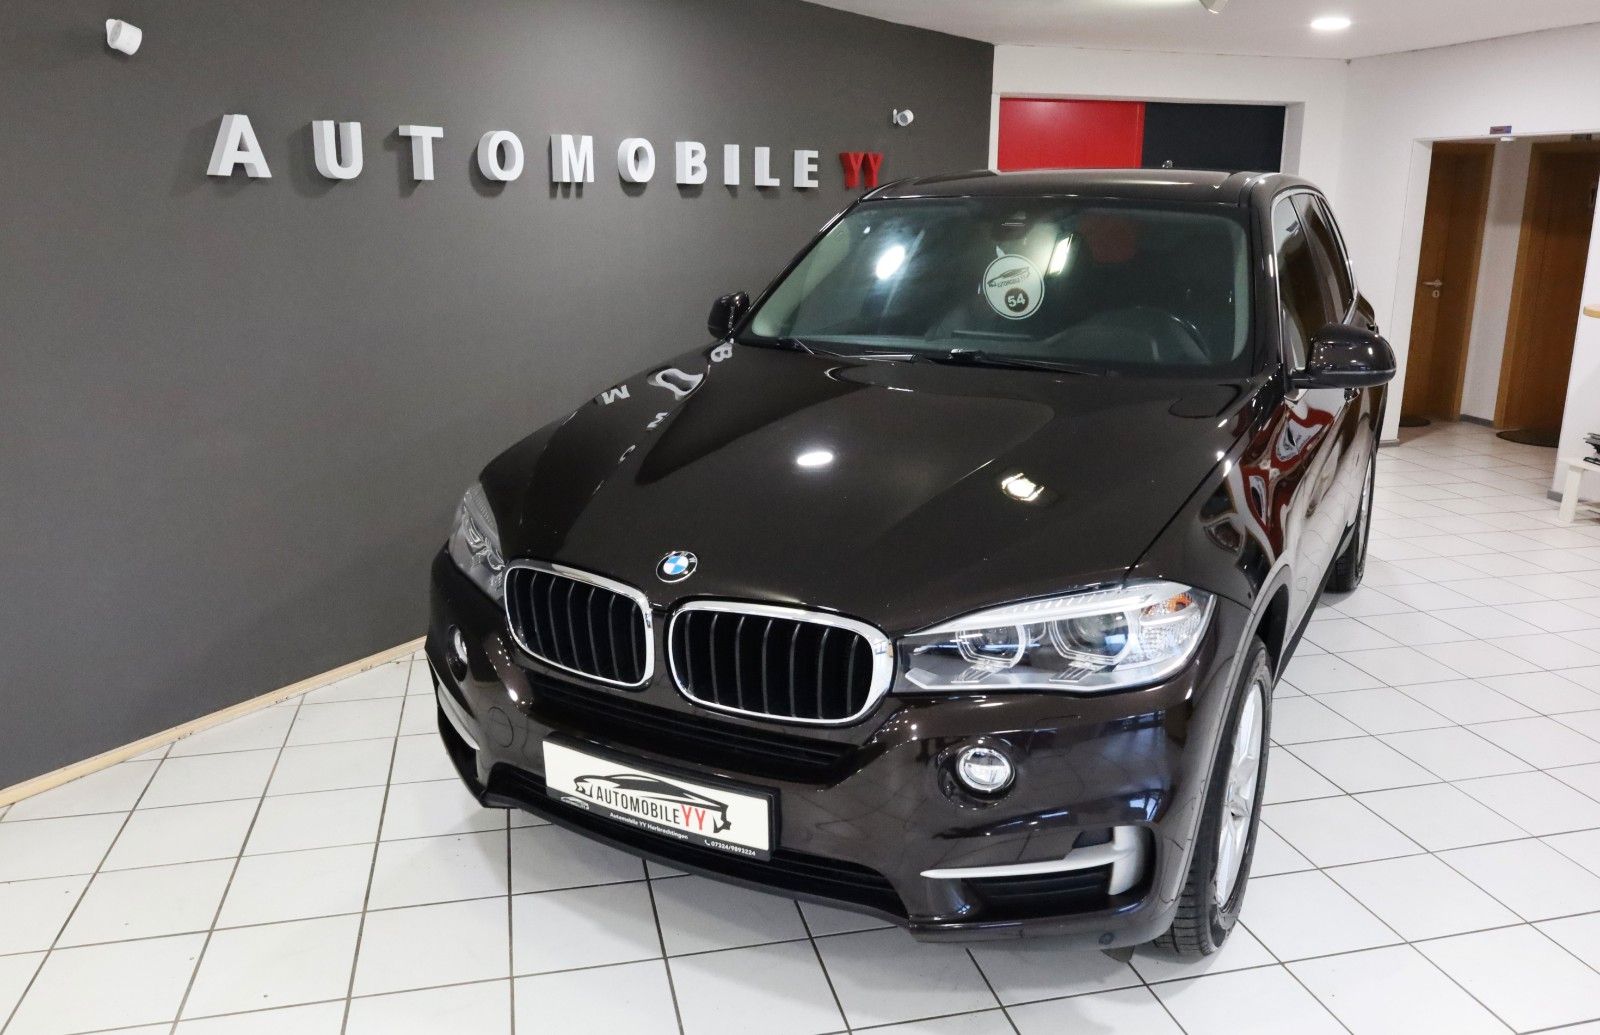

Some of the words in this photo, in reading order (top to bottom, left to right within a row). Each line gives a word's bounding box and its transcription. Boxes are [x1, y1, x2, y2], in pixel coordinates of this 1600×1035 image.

[206, 114, 818, 188] AUTOMOBILE
[840, 151, 884, 190] YY
[1007, 293, 1026, 307] 54
[609, 812, 639, 826] Automobile
